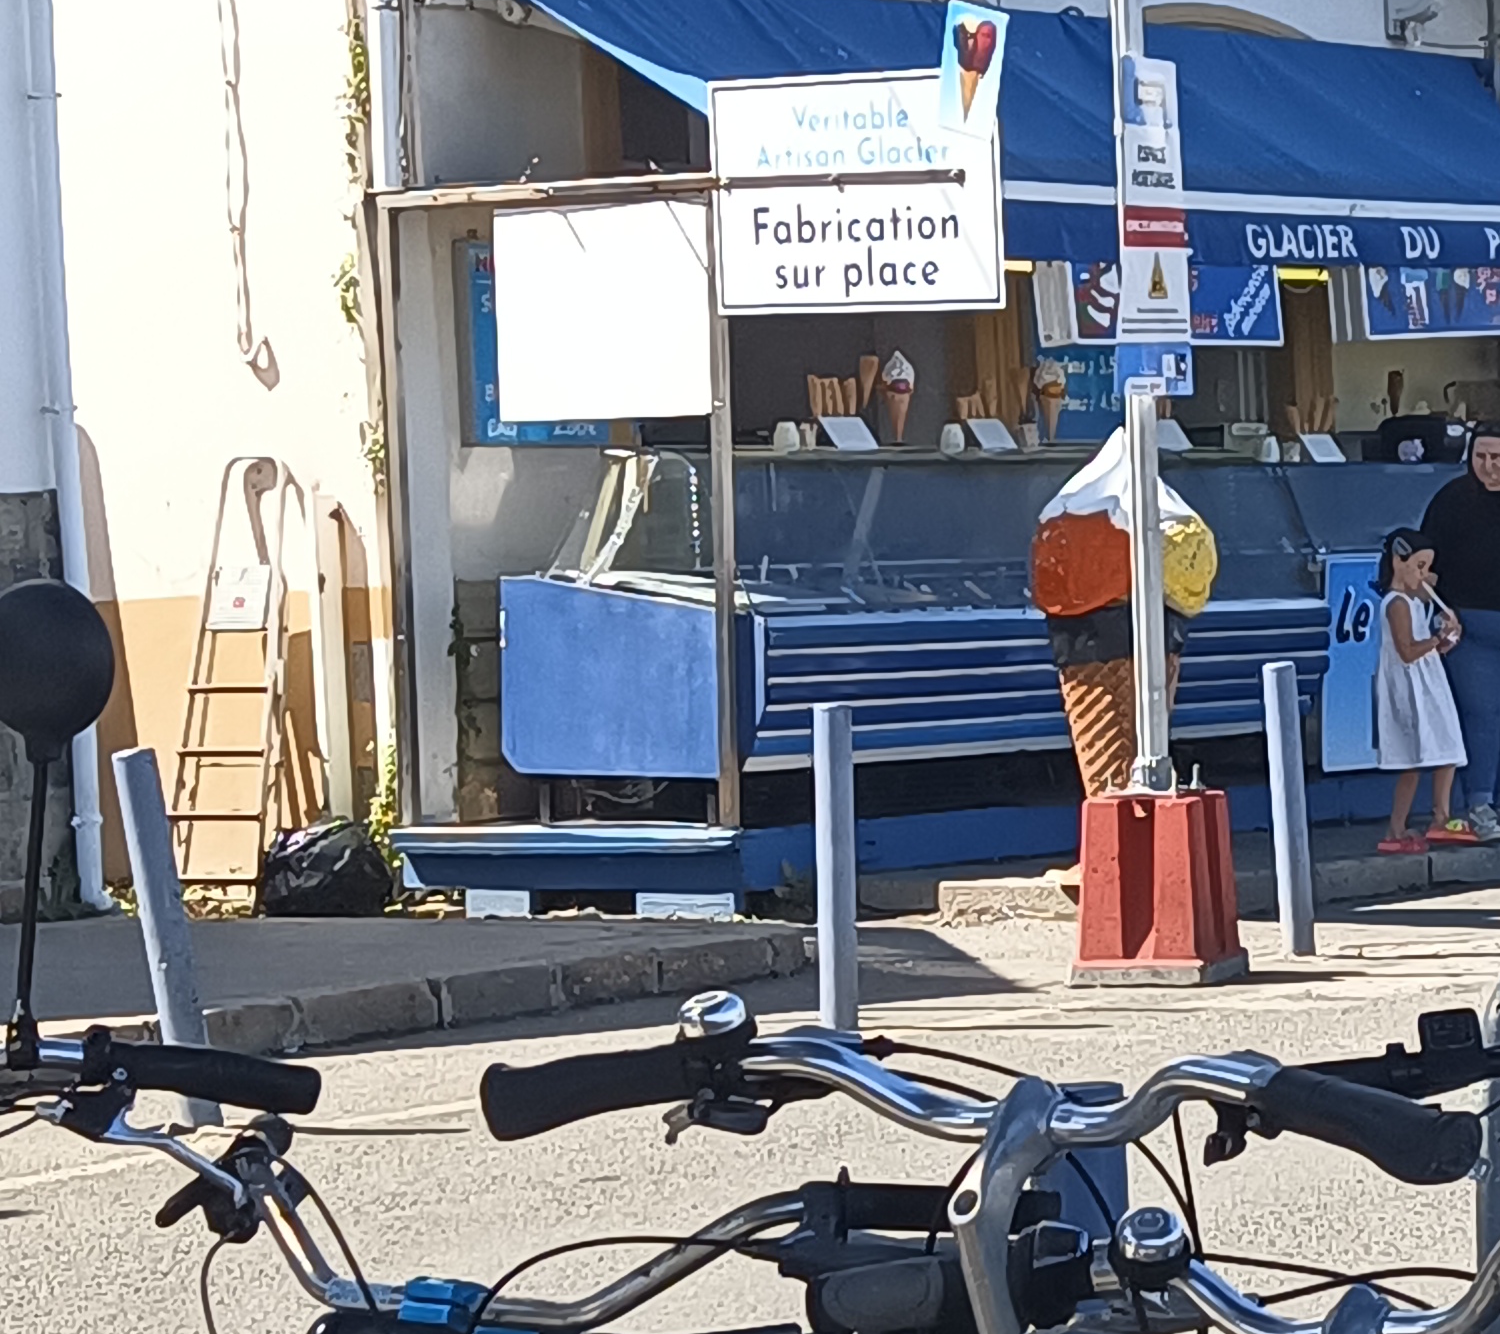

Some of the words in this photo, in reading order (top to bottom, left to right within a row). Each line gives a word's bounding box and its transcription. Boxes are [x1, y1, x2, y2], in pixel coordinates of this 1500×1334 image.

[753, 204, 960, 246] Fabrication
[1245, 223, 1359, 259] GLACIER
[1400, 225, 1441, 260] DU
[775, 263, 826, 290] sur
[843, 244, 940, 298] place
